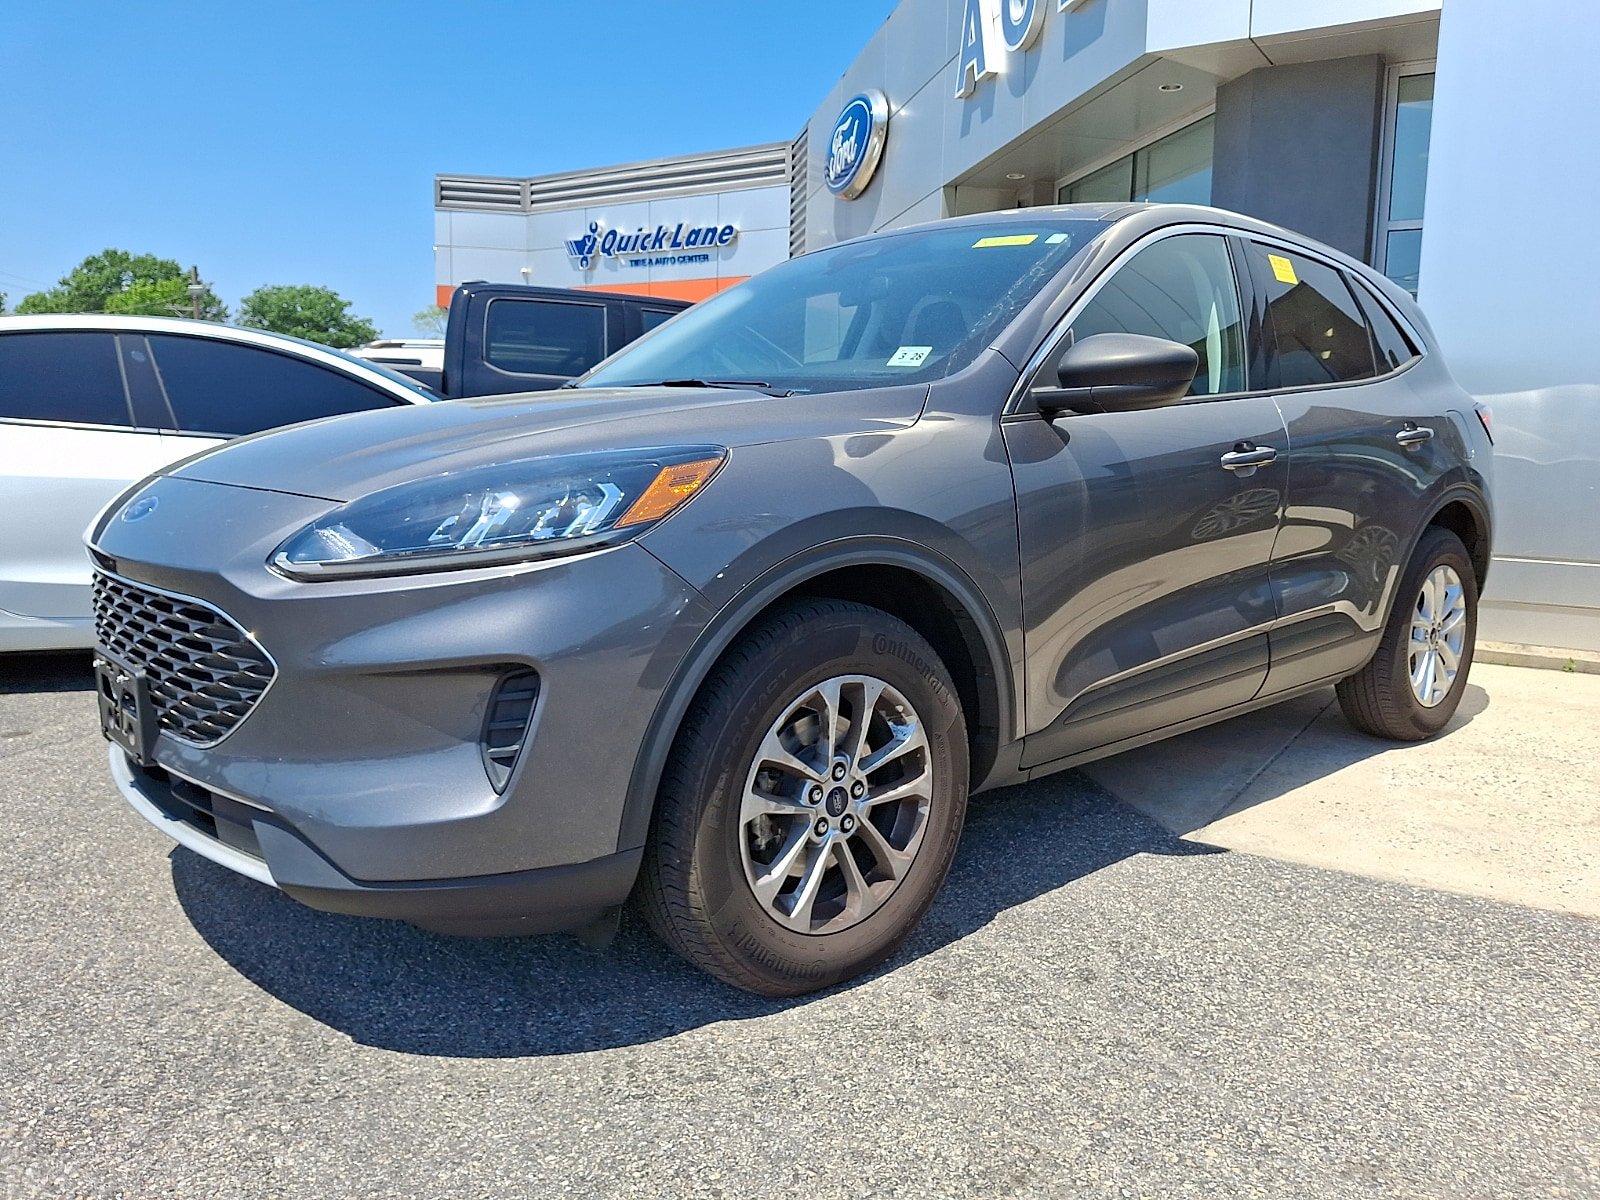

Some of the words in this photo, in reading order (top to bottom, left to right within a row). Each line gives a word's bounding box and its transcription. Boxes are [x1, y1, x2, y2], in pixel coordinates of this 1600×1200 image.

[828, 116, 859, 181] Ford
[601, 224, 668, 257] Quick
[670, 223, 734, 249] Lane
[629, 259, 647, 267] TIRE
[655, 256, 676, 266] AUTO
[677, 254, 709, 264] CENTER
[872, 632, 941, 695] Continental
